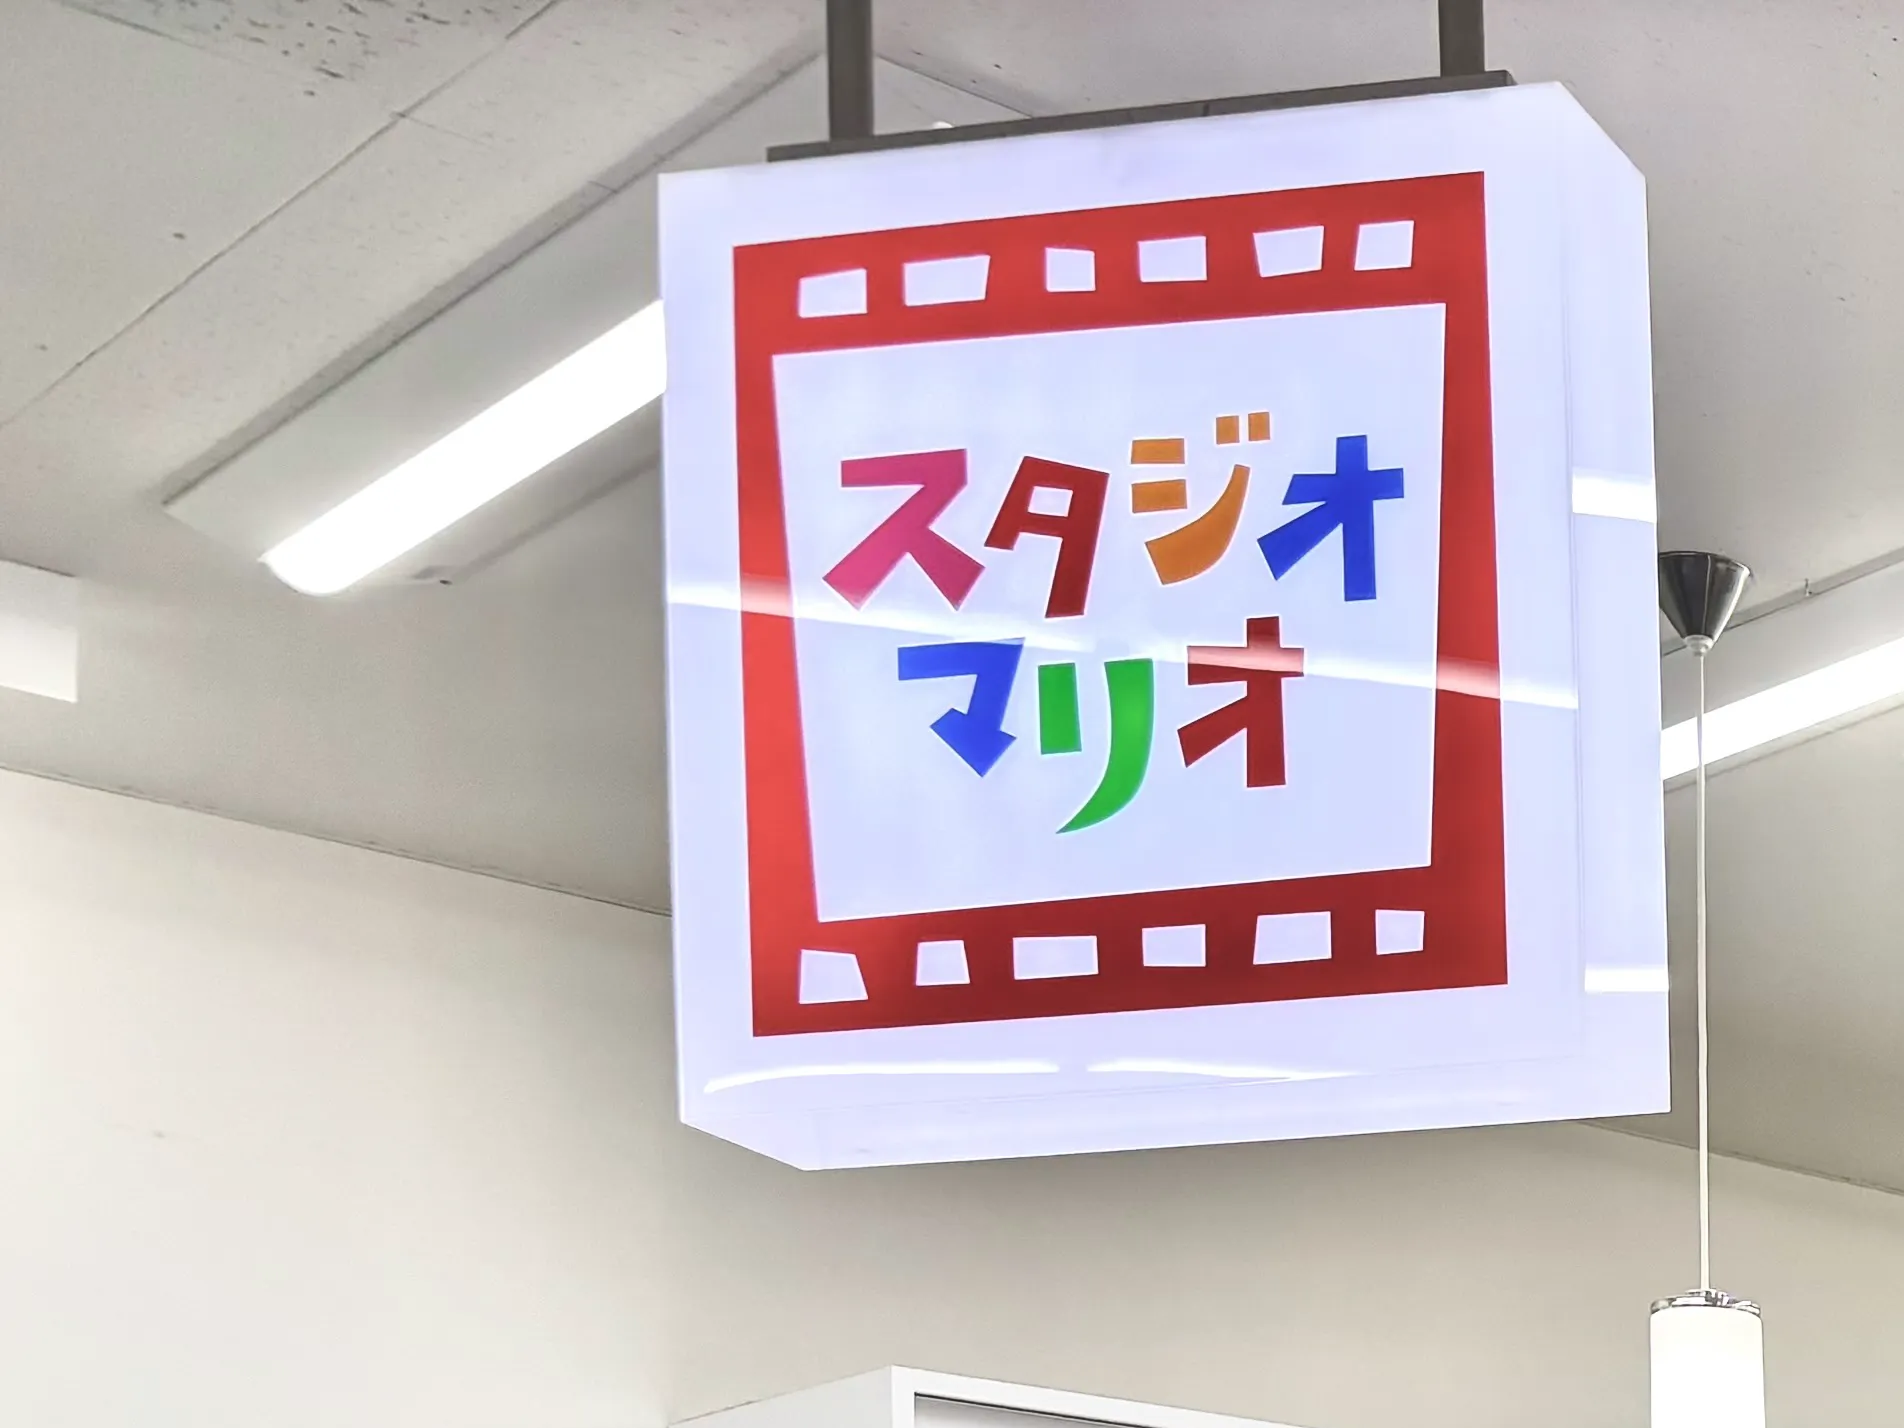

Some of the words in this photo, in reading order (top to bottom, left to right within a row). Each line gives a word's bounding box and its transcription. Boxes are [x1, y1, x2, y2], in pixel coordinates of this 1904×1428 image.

[822, 411, 1405, 619] スタジオ
[896, 615, 1305, 835] マリオ
